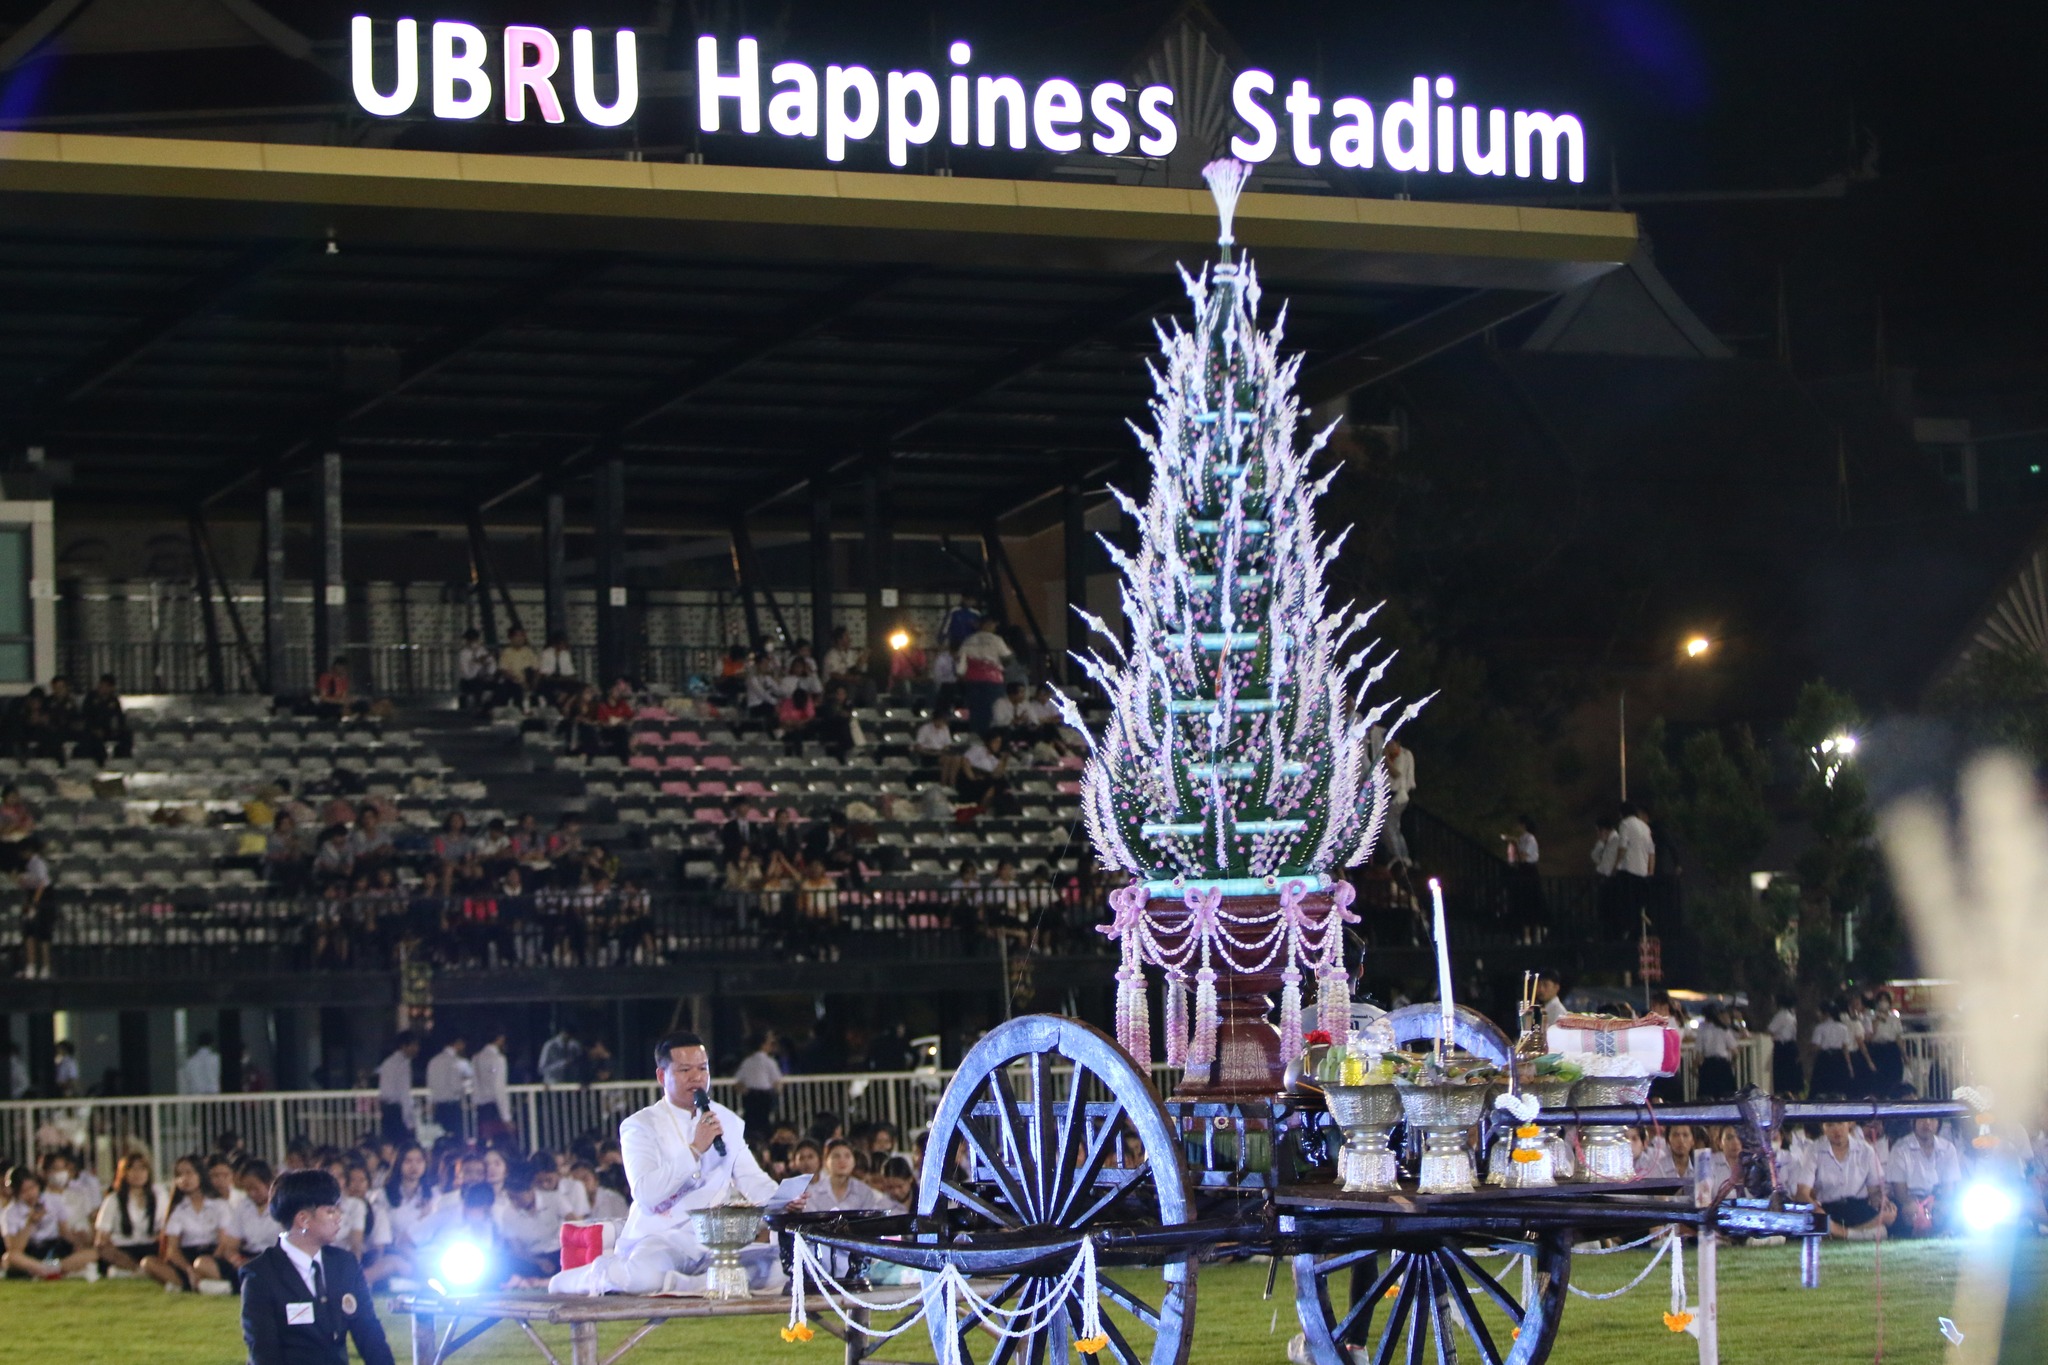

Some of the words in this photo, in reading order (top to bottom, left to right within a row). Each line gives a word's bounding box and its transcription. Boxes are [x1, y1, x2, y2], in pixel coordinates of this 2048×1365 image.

[351, 15, 639, 127] UBRU
[697, 36, 1178, 167] Happiness
[1230, 70, 1585, 184] Stadium
